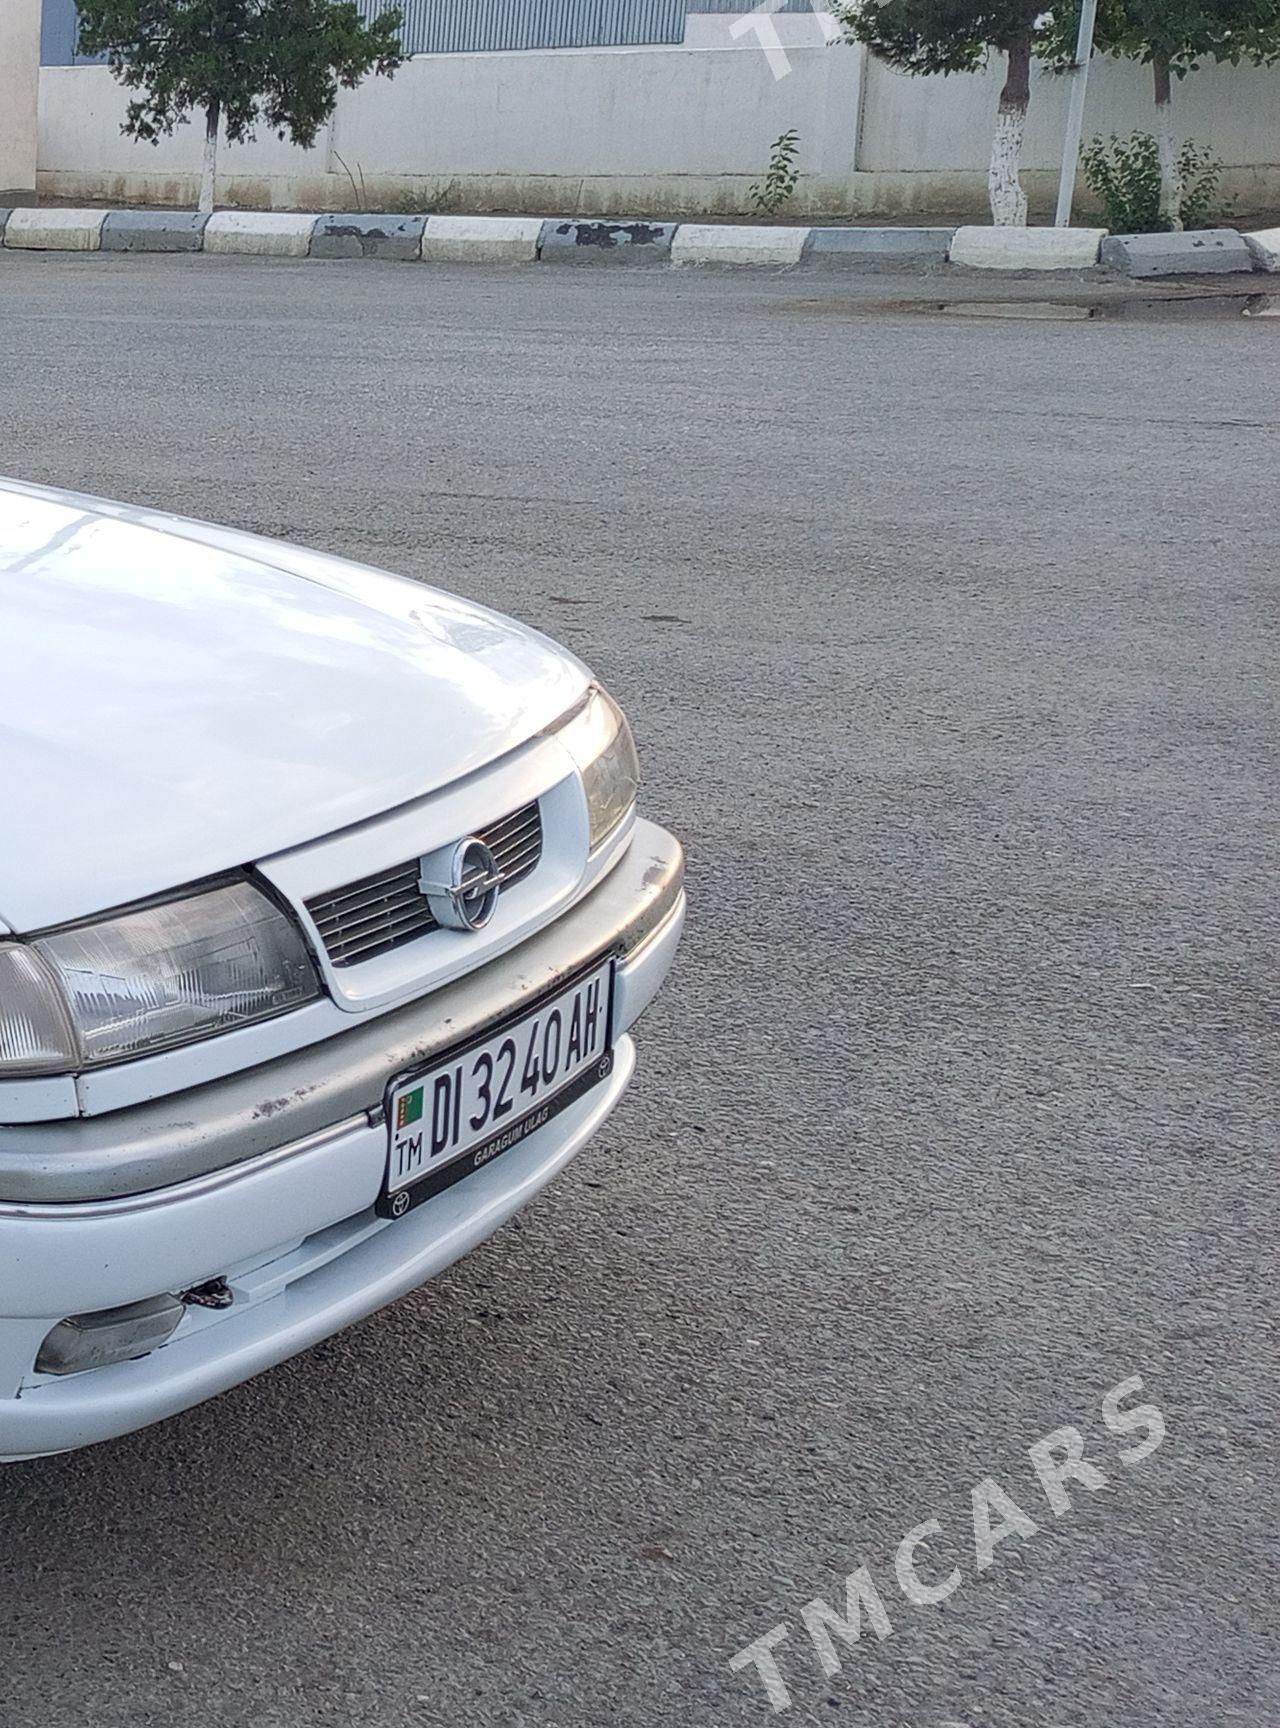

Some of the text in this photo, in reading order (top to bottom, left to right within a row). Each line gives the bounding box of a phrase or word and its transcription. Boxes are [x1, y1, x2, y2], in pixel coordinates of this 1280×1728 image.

[469, 1038, 517, 1131] 32
[520, 1006, 562, 1096] 40
[565, 977, 600, 1072] AH
[395, 1131, 423, 1176] TM
